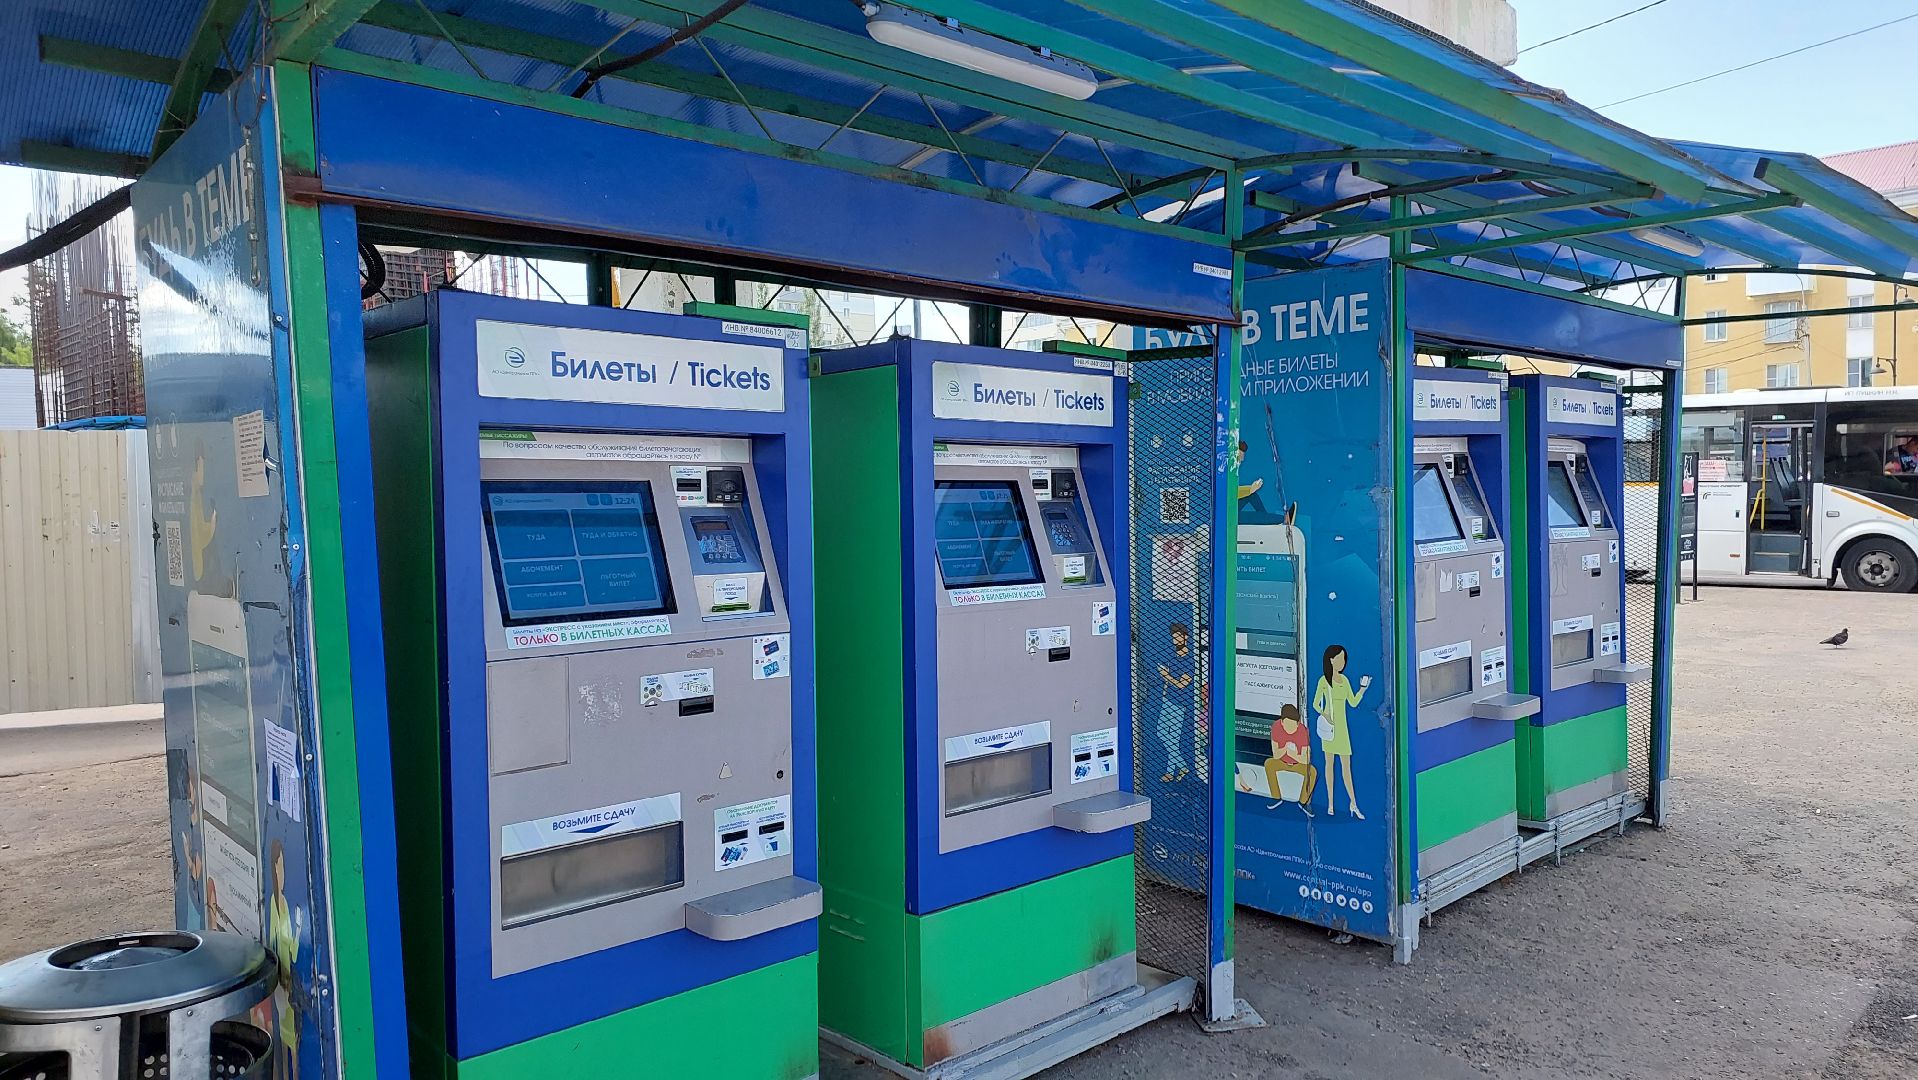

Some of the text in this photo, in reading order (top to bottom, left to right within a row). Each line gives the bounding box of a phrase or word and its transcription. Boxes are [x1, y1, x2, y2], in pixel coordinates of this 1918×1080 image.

[182, 191, 197, 258] В
[1241, 309, 1261, 346] В
[1270, 292, 1369, 342] ТЕМЕ
[551, 350, 771, 391] Билеты / Tickets
[1278, 352, 1339, 372] БИЛЕТЫ
[1255, 370, 1369, 396] ПРИЛОЖЕНИИ
[973, 383, 1105, 411] Билеты / Tickets
[1430, 393, 1462, 409] Билеты
[1470, 394, 1497, 411] Tickets
[1562, 398, 1587, 413] Билеты
[1592, 401, 1614, 416] Tickets
[615, 497, 636, 505] 12:24
[527, 534, 546, 542] ТУДА
[955, 595, 980, 604] ТОЛЬКО
[514, 623, 670, 646] ТОЛЬКО В БИЛЕТНЫХ КАССАХ
[1244, 680, 1284, 691] ПАССАЖИРСКИЙ
[552, 806, 636, 831] ВОЗЬМИТЕ СДАЧУ
